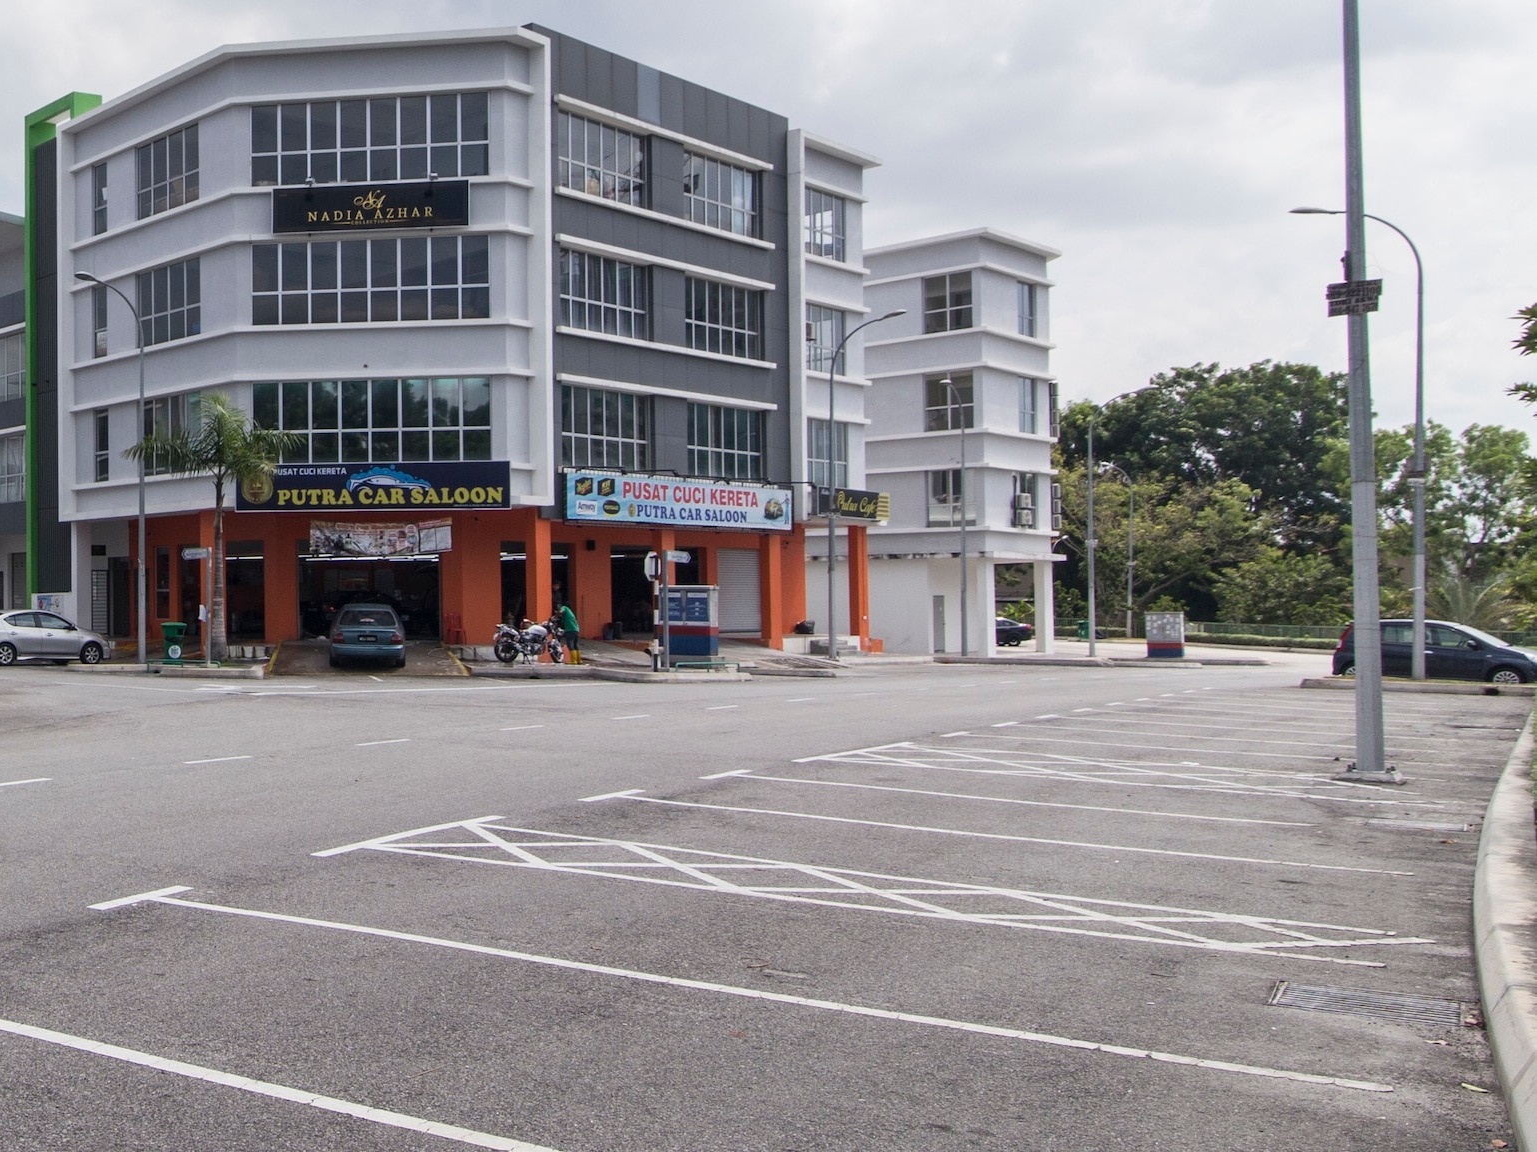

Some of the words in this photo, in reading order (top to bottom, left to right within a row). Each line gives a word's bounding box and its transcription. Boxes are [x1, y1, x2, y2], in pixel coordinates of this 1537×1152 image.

[307, 210, 364, 222] NADIA
[374, 206, 433, 219] AZHAR
[317, 467, 347, 475] KERETA
[277, 489, 353, 505] PUTRA
[358, 489, 406, 504] CAR
[410, 487, 503, 503] SALOON
[623, 481, 670, 502] PUSAT
[673, 486, 706, 504] CUCI
[710, 489, 759, 507] KERETA
[637, 504, 677, 519] PUTRA
[680, 509, 702, 521] CAR
[705, 511, 747, 523] SALOON
